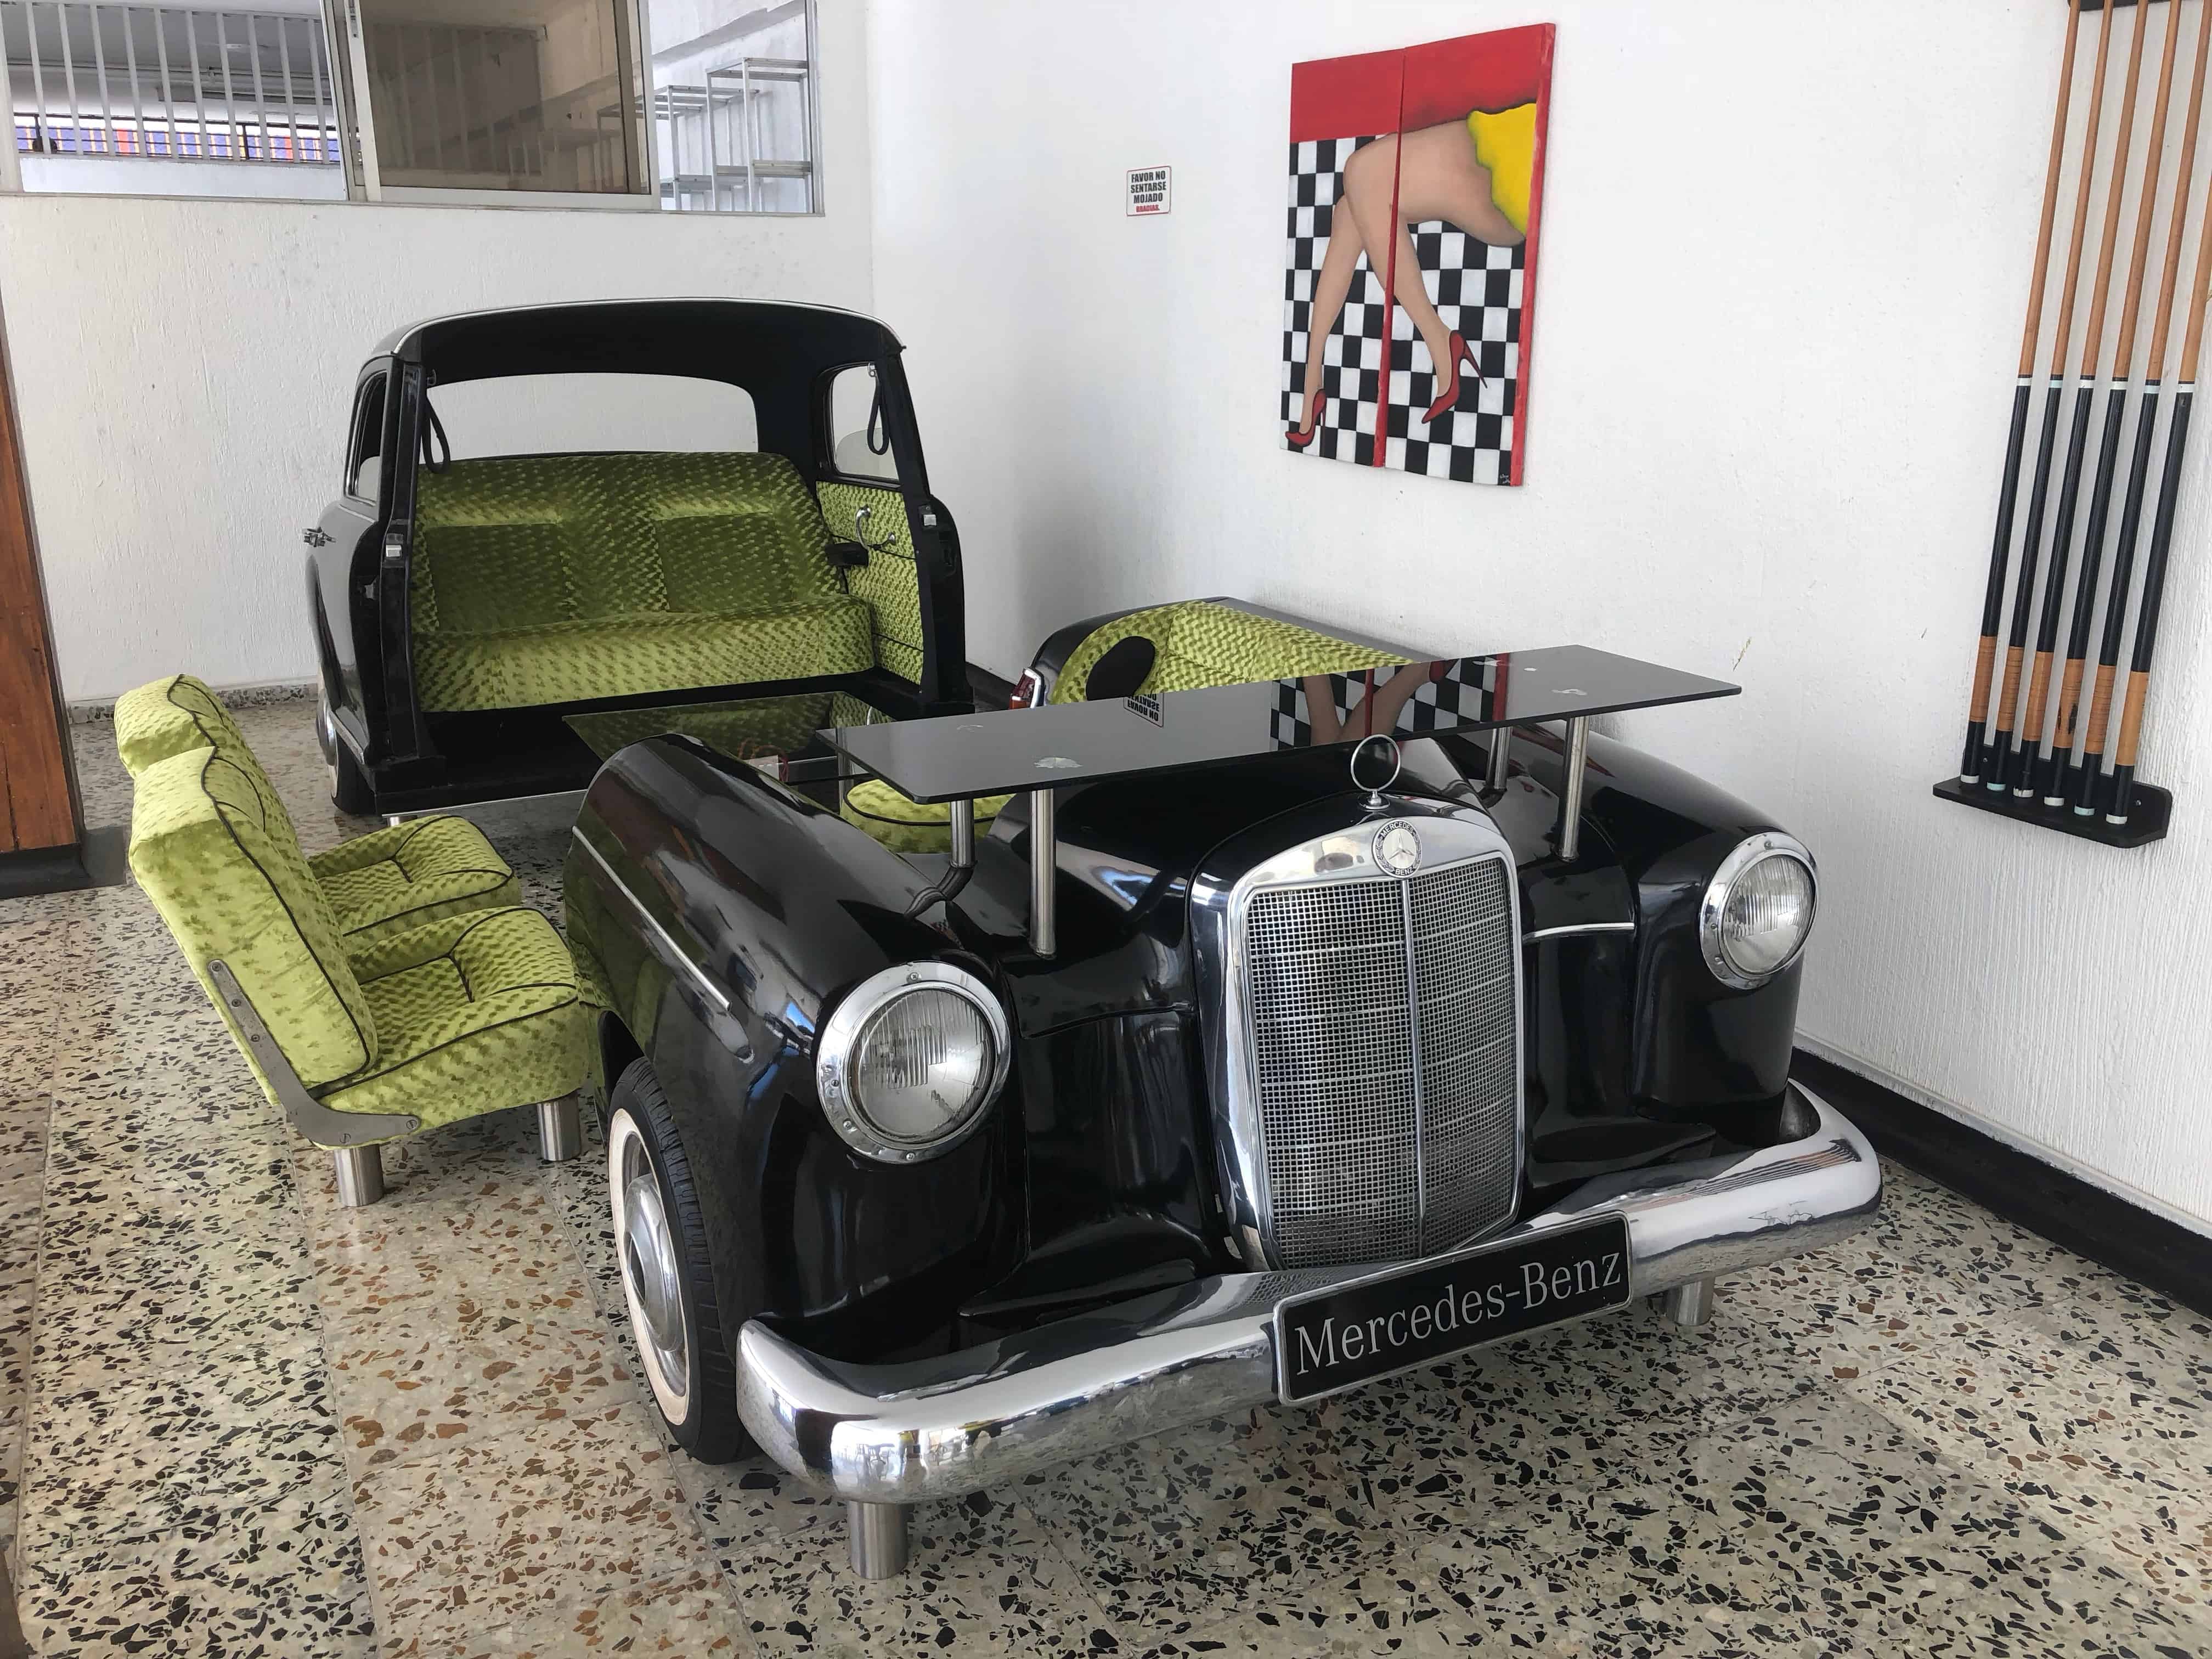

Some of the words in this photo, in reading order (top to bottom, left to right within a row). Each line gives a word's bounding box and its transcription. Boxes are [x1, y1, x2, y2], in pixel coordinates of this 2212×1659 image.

[1131, 172, 1154, 183] FAVOR
[1155, 170, 1165, 180] NO
[1131, 182, 1166, 193] SENTARSE
[1133, 193, 1163, 204] MOJADO
[1380, 821, 1414, 837] MERCEDES
[1395, 866, 1414, 876] BENZ
[1294, 1250, 1622, 1376] Mercedes-Benz
